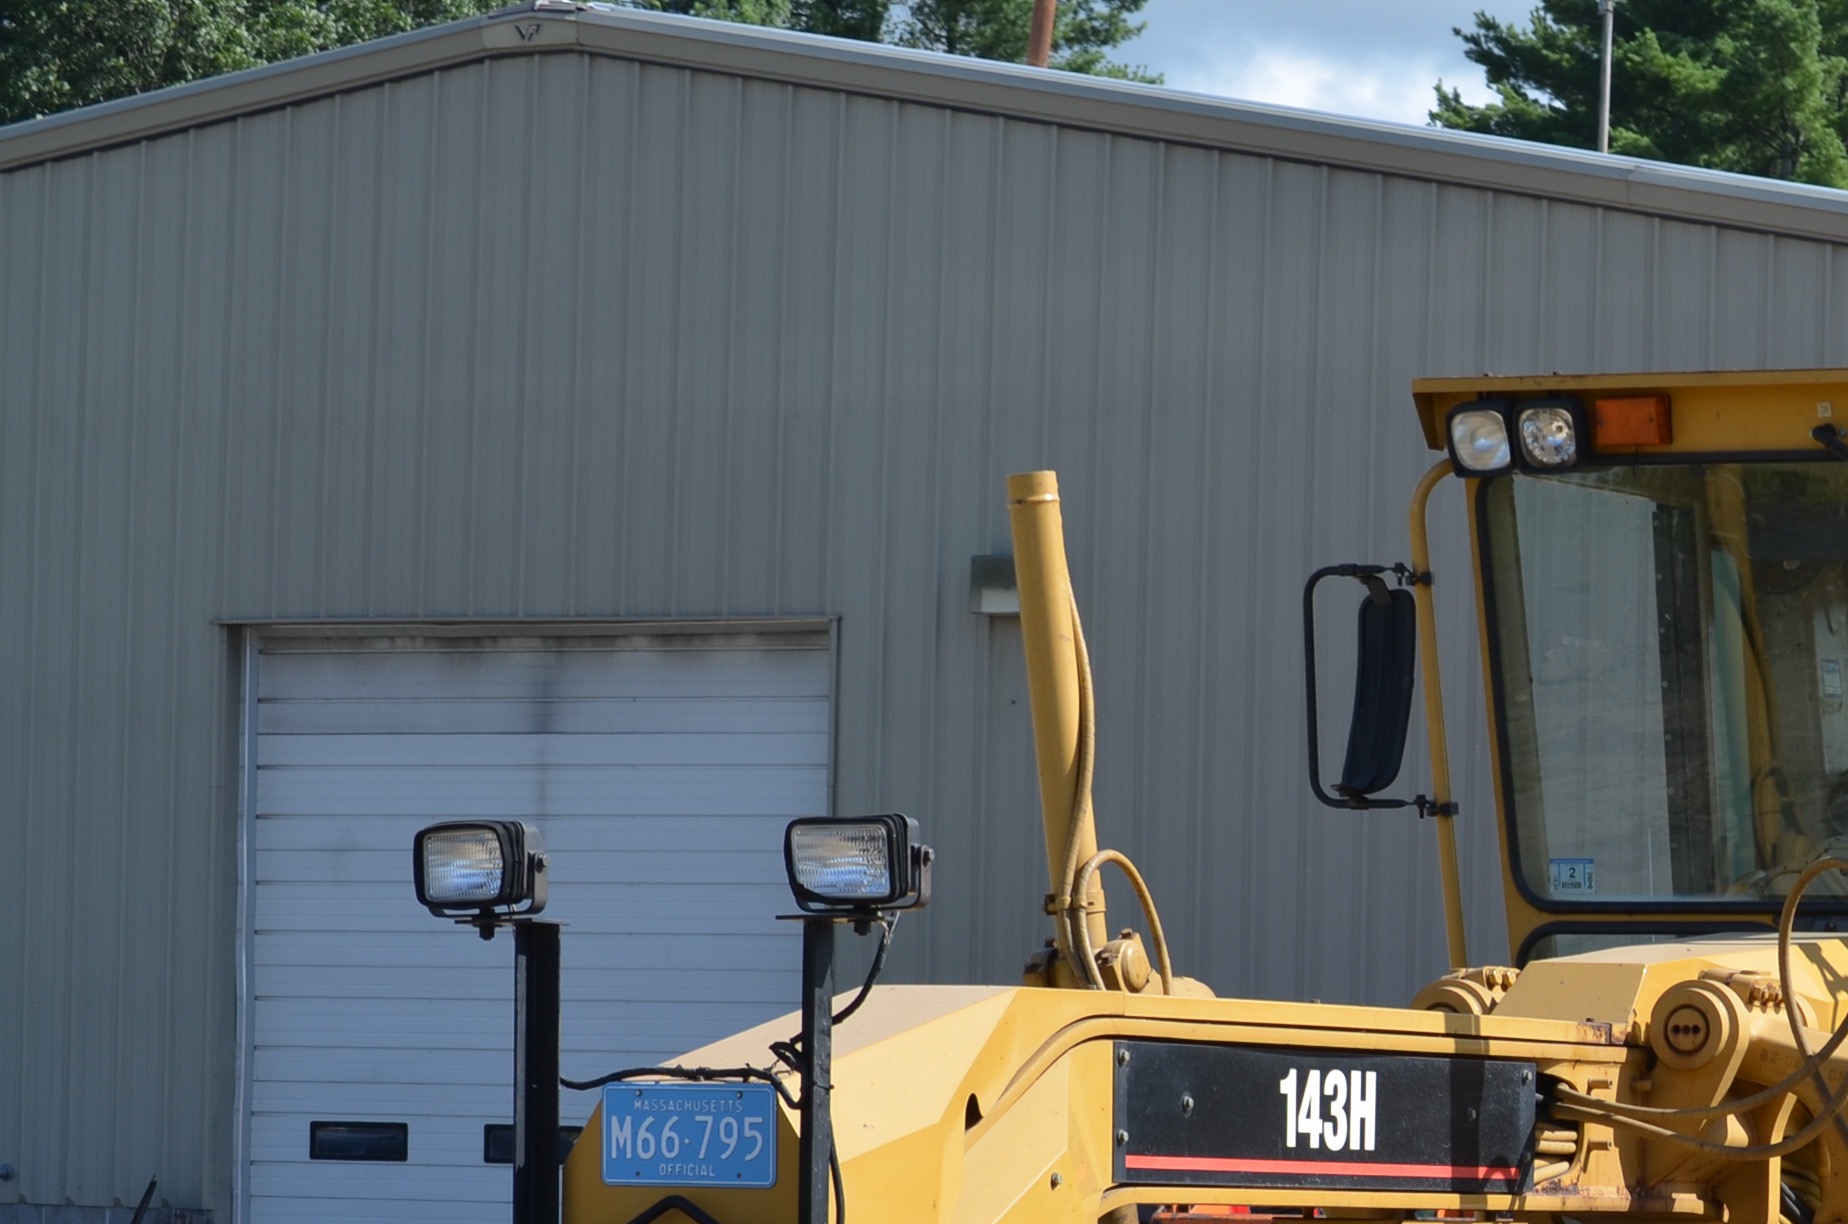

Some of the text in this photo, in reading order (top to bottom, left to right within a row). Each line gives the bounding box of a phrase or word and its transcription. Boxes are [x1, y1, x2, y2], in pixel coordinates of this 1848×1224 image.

[1569, 867, 1576, 878] 2
[633, 1099, 743, 1113] MASSACHUSETTS
[1279, 1068, 1377, 1152] 143H
[658, 1163, 716, 1178] OFFICIAL
